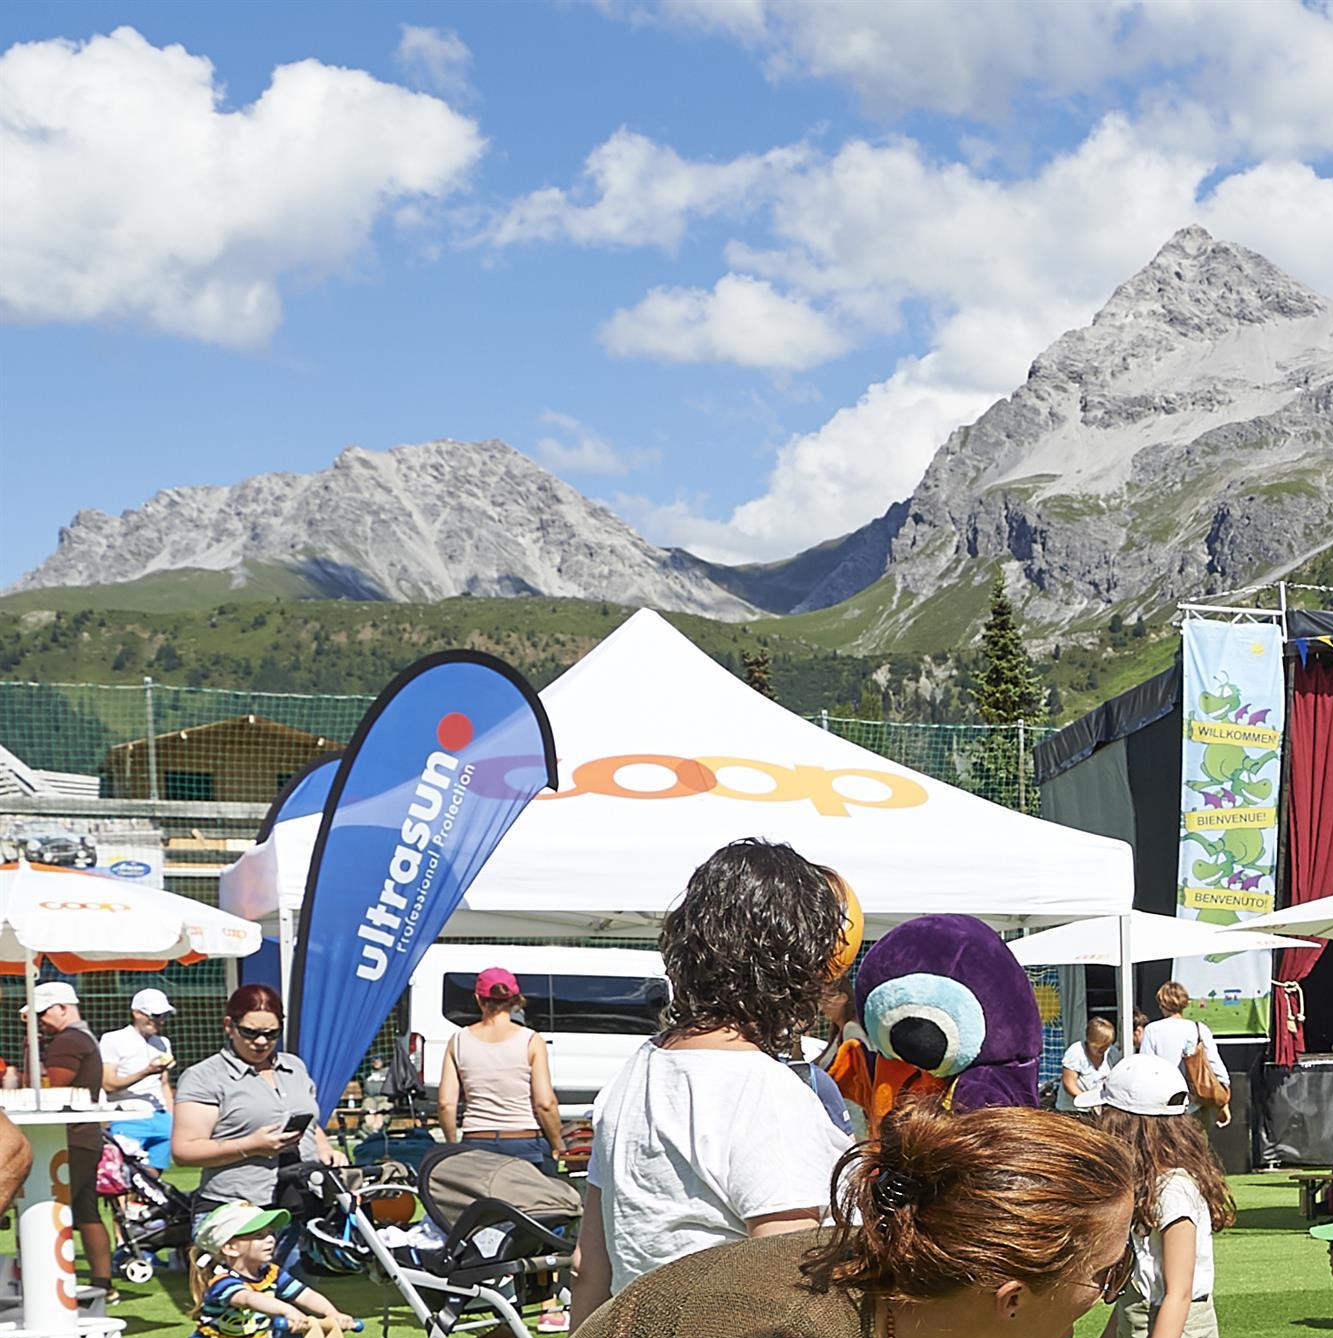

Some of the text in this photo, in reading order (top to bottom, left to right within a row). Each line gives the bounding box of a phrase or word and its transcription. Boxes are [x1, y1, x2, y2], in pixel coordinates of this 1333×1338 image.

[1197, 812, 1268, 826] BIENVENUE!
[396, 763, 476, 953] Professional Protection
[356, 751, 459, 982] ultrasun
[39, 901, 131, 912] coop
[1195, 892, 1268, 908] BENVENUTO!
